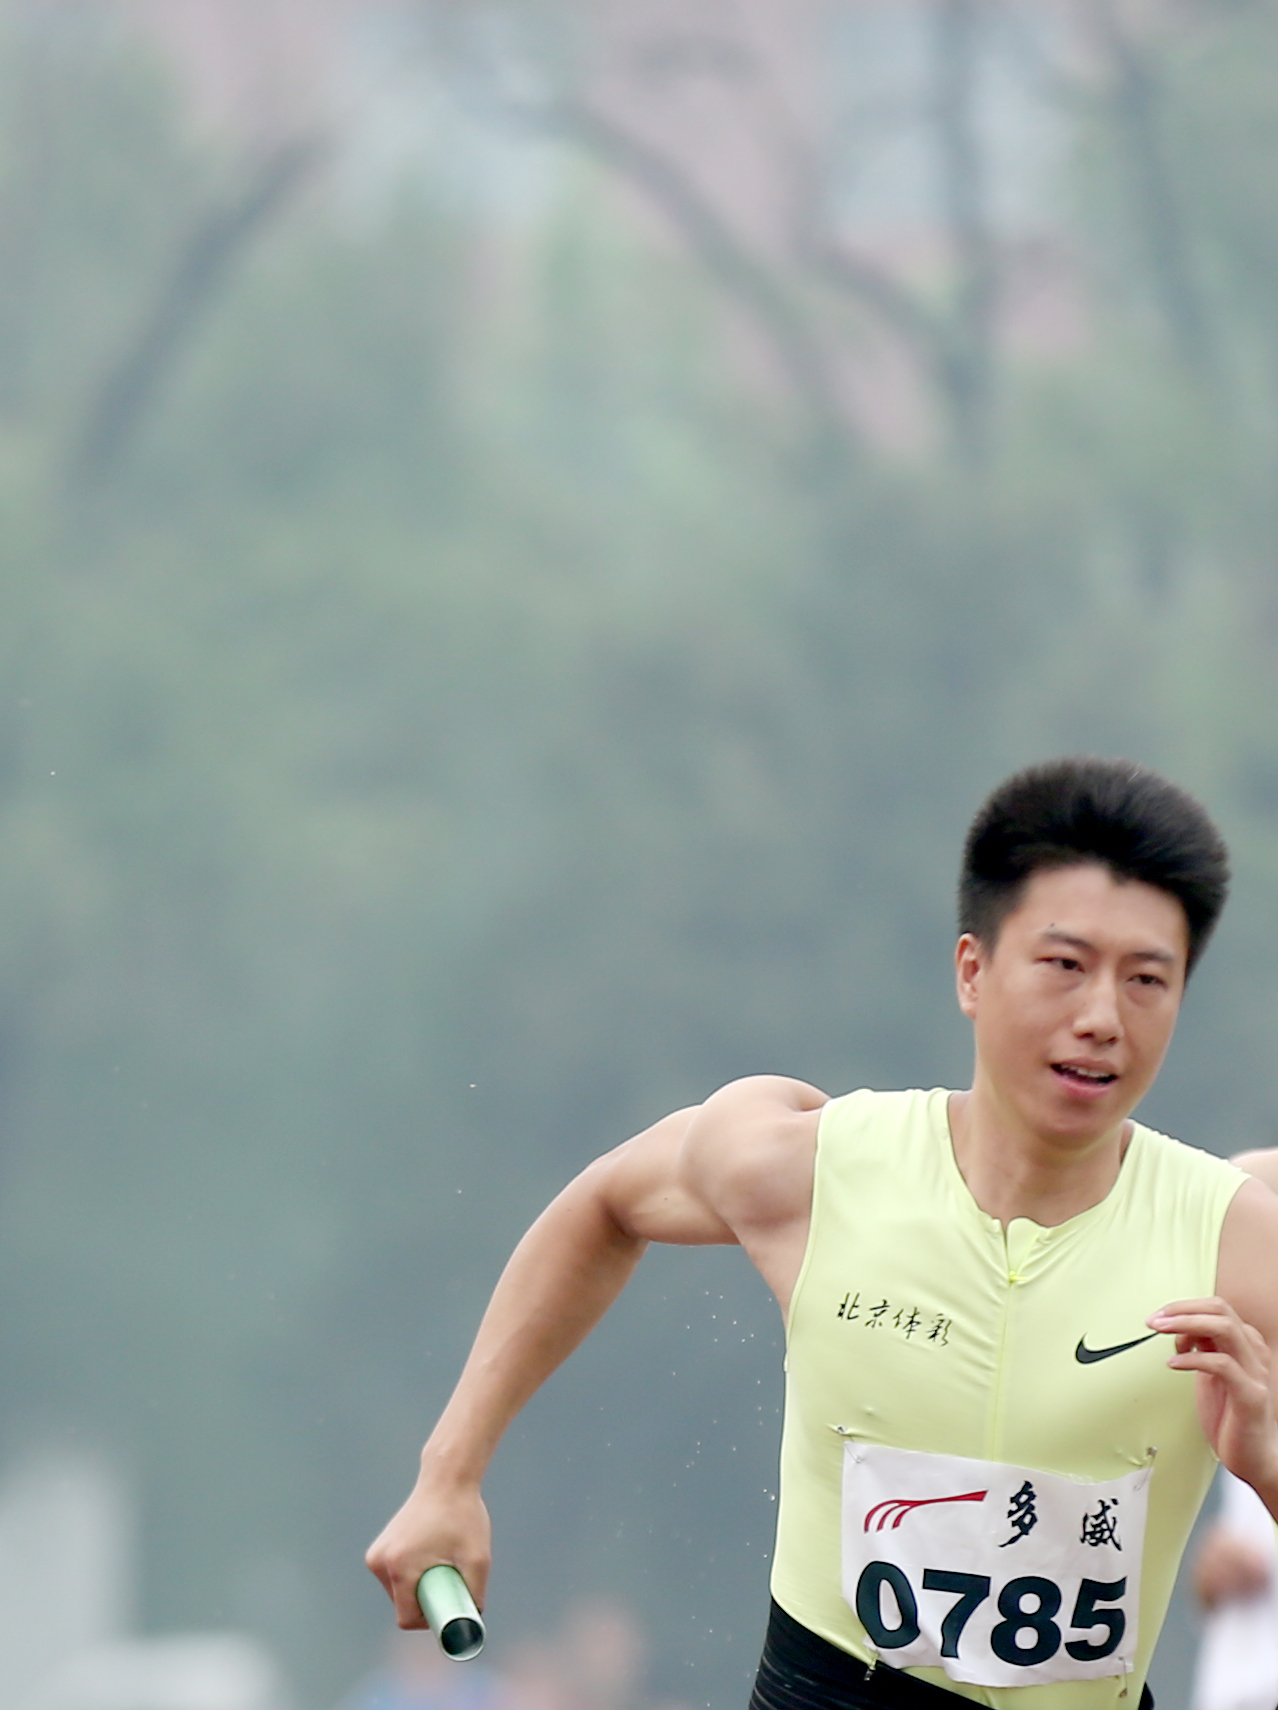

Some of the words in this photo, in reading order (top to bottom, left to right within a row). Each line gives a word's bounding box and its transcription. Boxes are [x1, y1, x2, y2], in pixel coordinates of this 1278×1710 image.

[837, 1291, 952, 1347] 北京体彩
[998, 1480, 1122, 1552] 多威
[855, 1560, 1127, 1667] 0785
